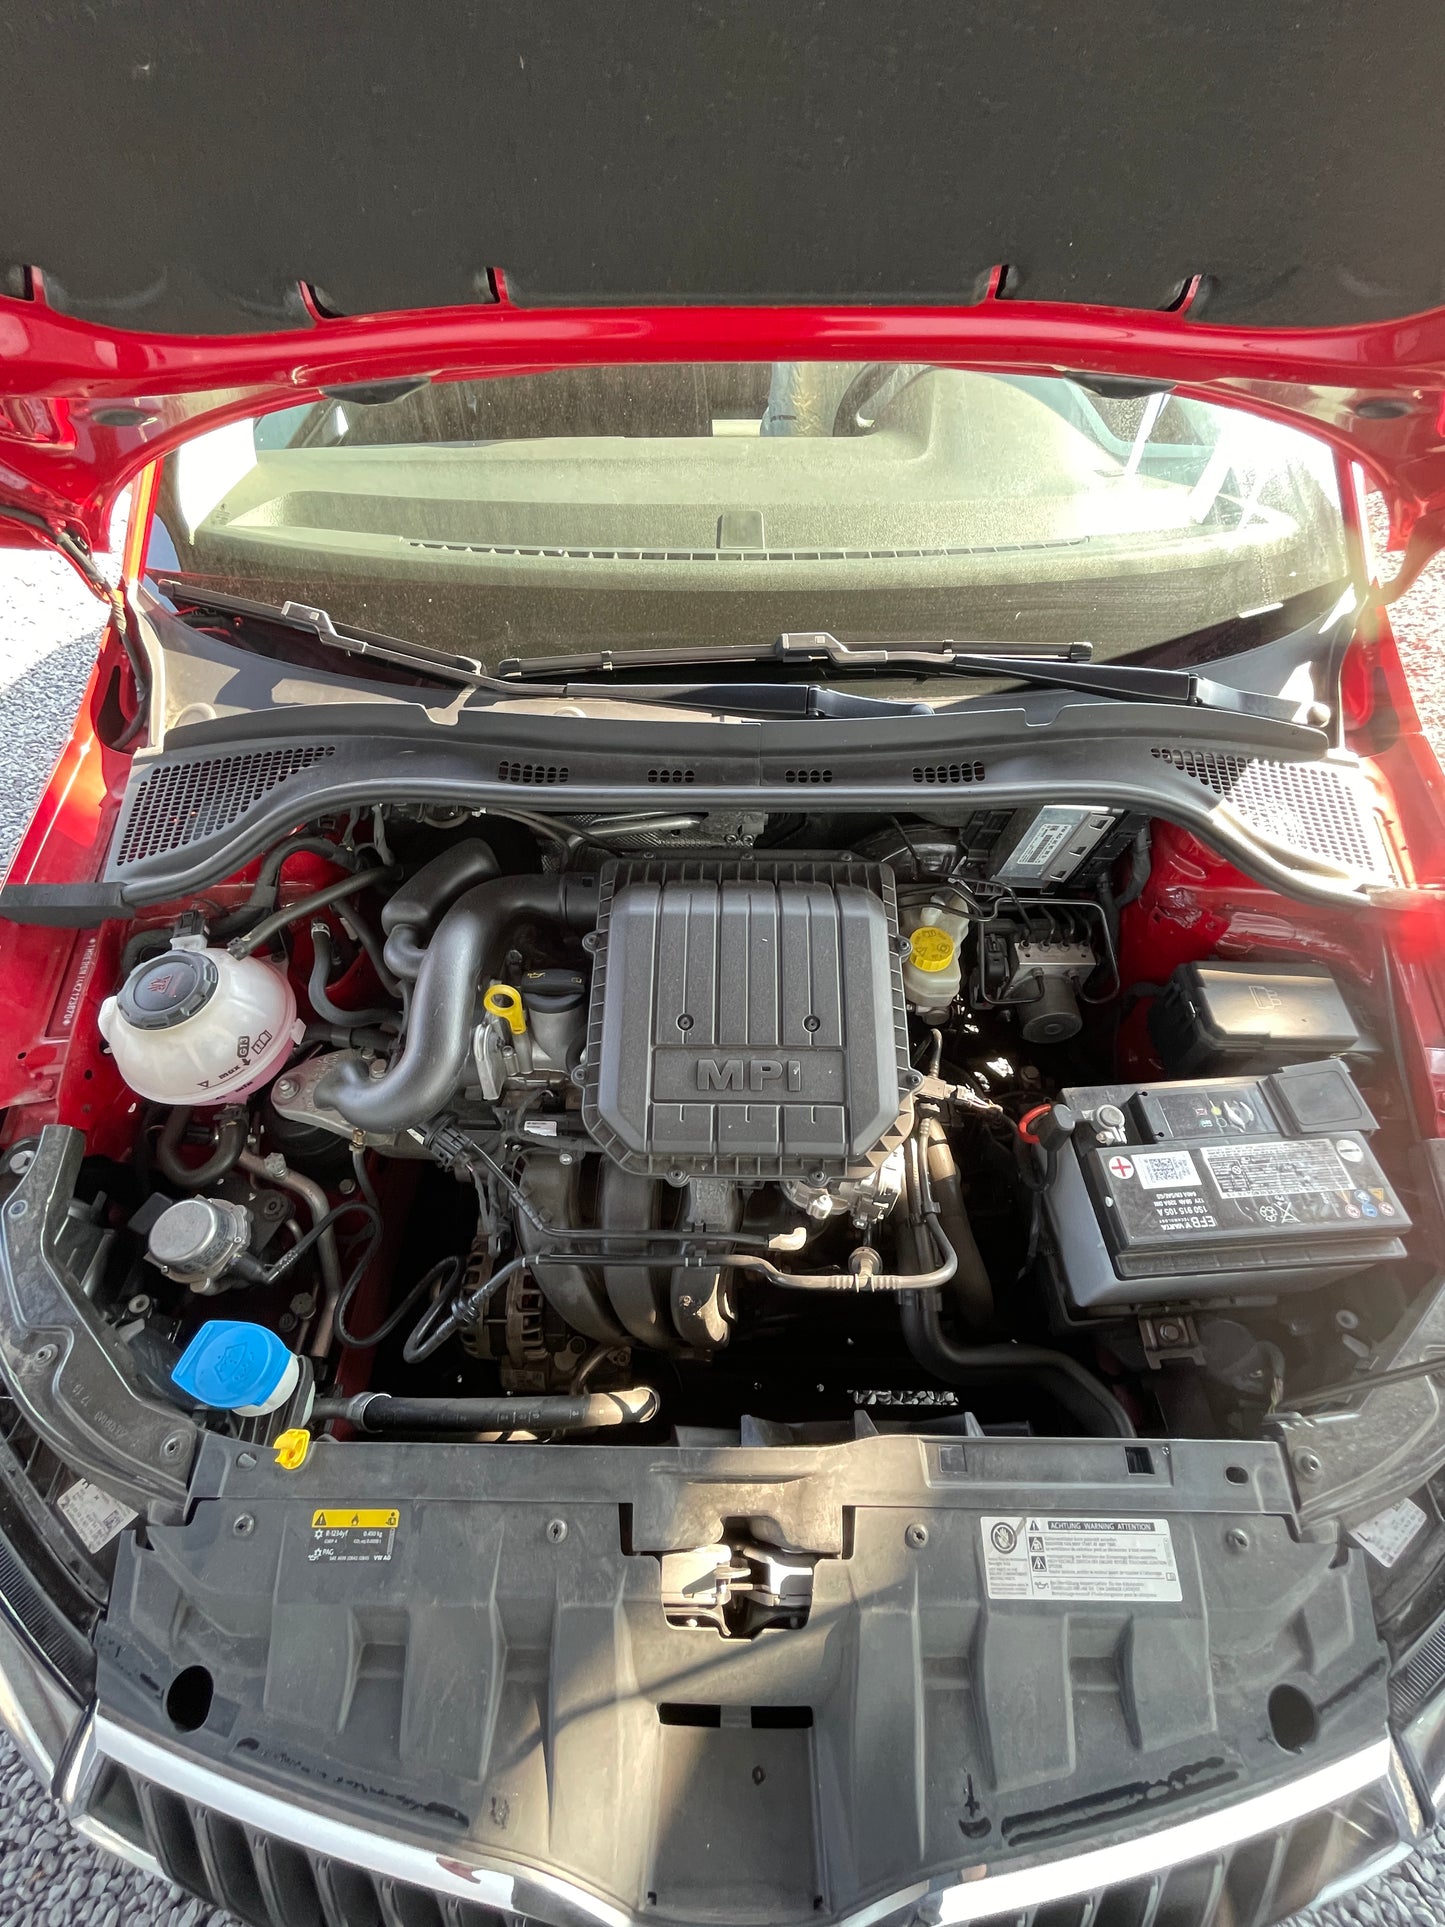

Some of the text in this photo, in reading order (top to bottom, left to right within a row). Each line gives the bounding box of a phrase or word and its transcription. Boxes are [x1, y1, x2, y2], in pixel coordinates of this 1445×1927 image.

[696, 1058, 802, 1092] MPI
[1156, 1208, 1164, 1217] A
[1164, 1207, 1179, 1216] 105
[1178, 1206, 1194, 1215] 915
[1190, 1215, 1217, 1228] EFB
[1050, 1521, 1152, 1531] ACHTUNG WARNING ATTENTION
